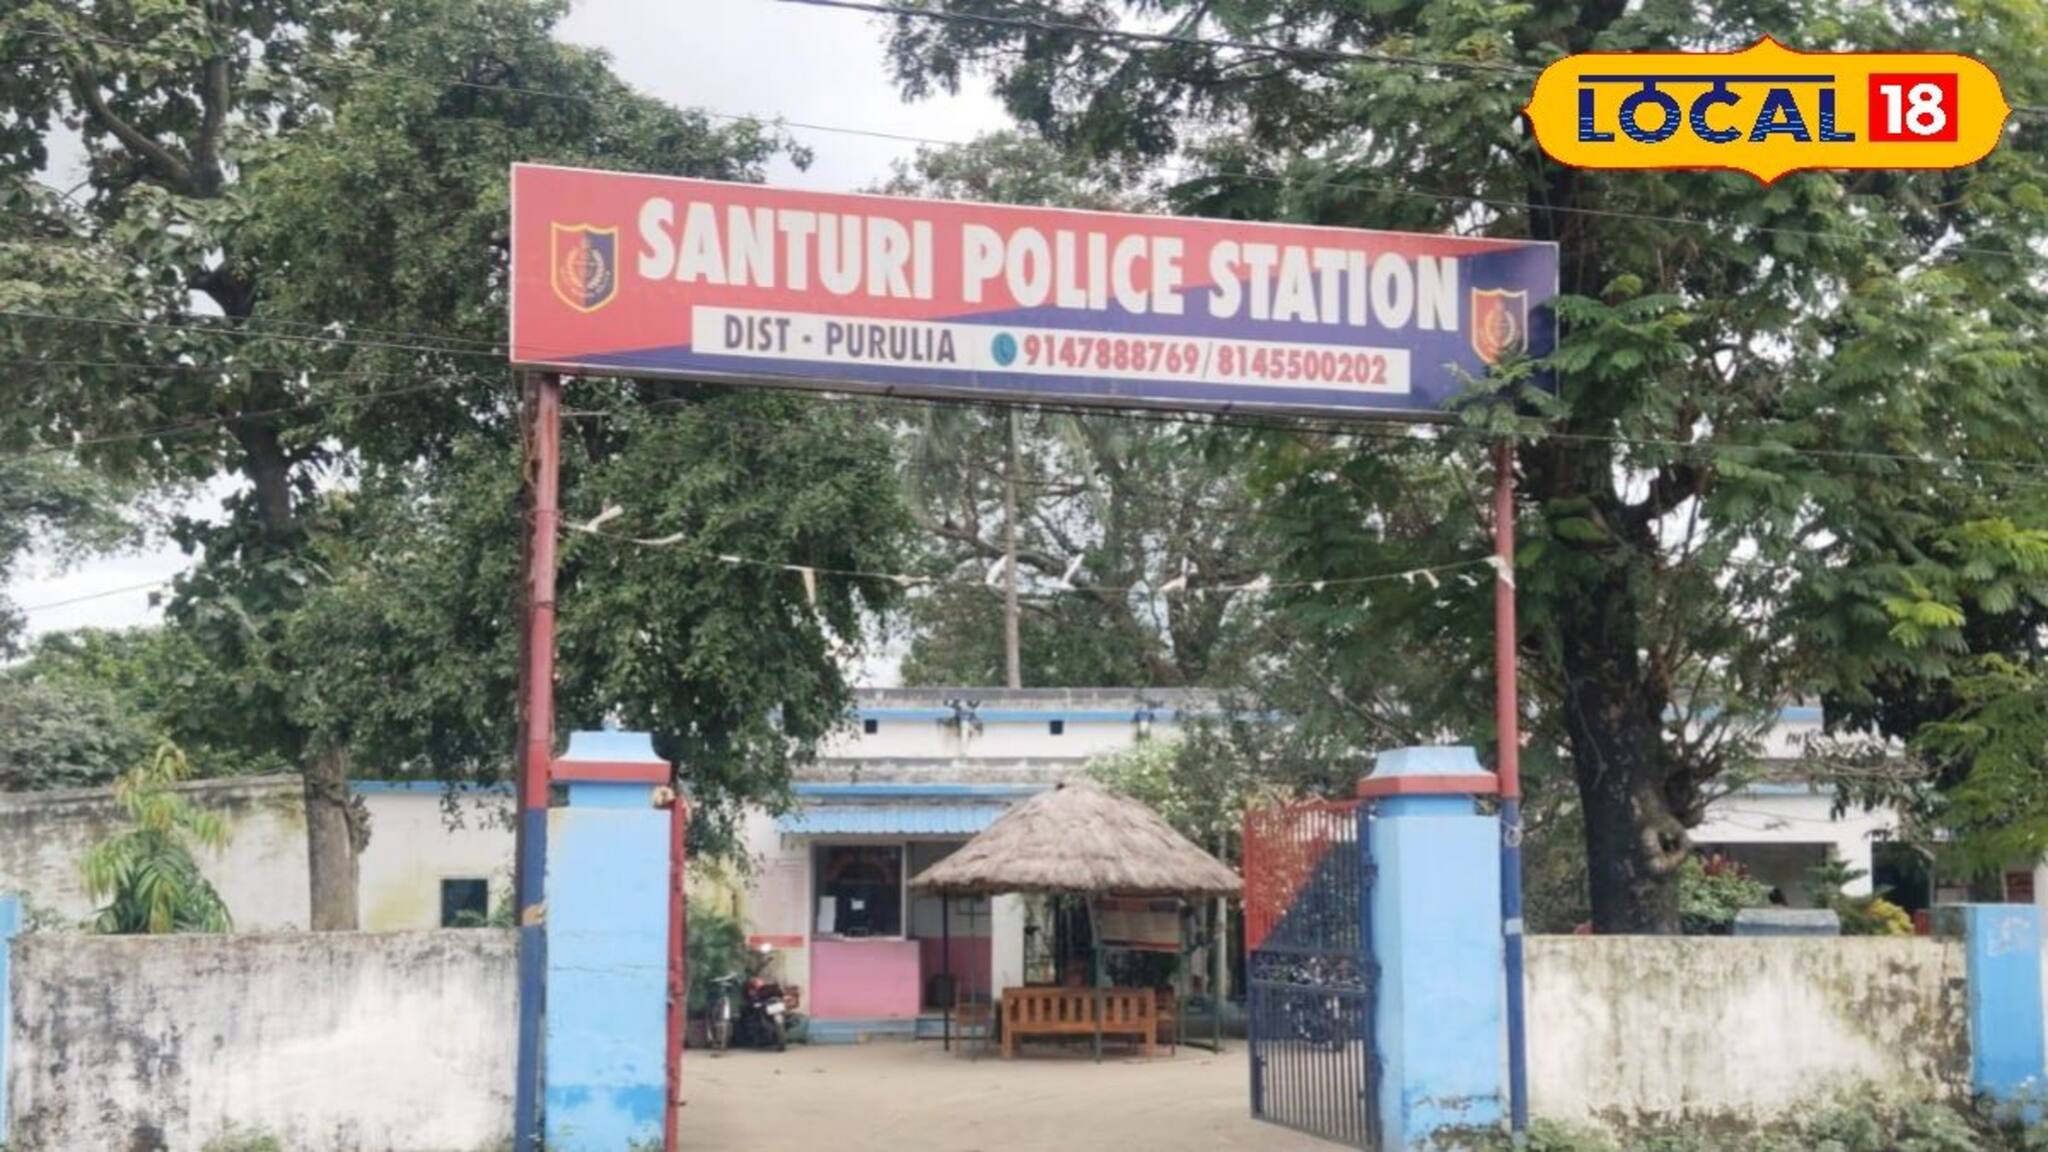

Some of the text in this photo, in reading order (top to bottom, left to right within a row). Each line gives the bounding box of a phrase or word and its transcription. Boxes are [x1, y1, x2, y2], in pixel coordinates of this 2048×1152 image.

[637, 197, 1459, 332] SANTURI POLICE STATION
[724, 314, 790, 353] DIST
[826, 321, 956, 363] PURULIA
